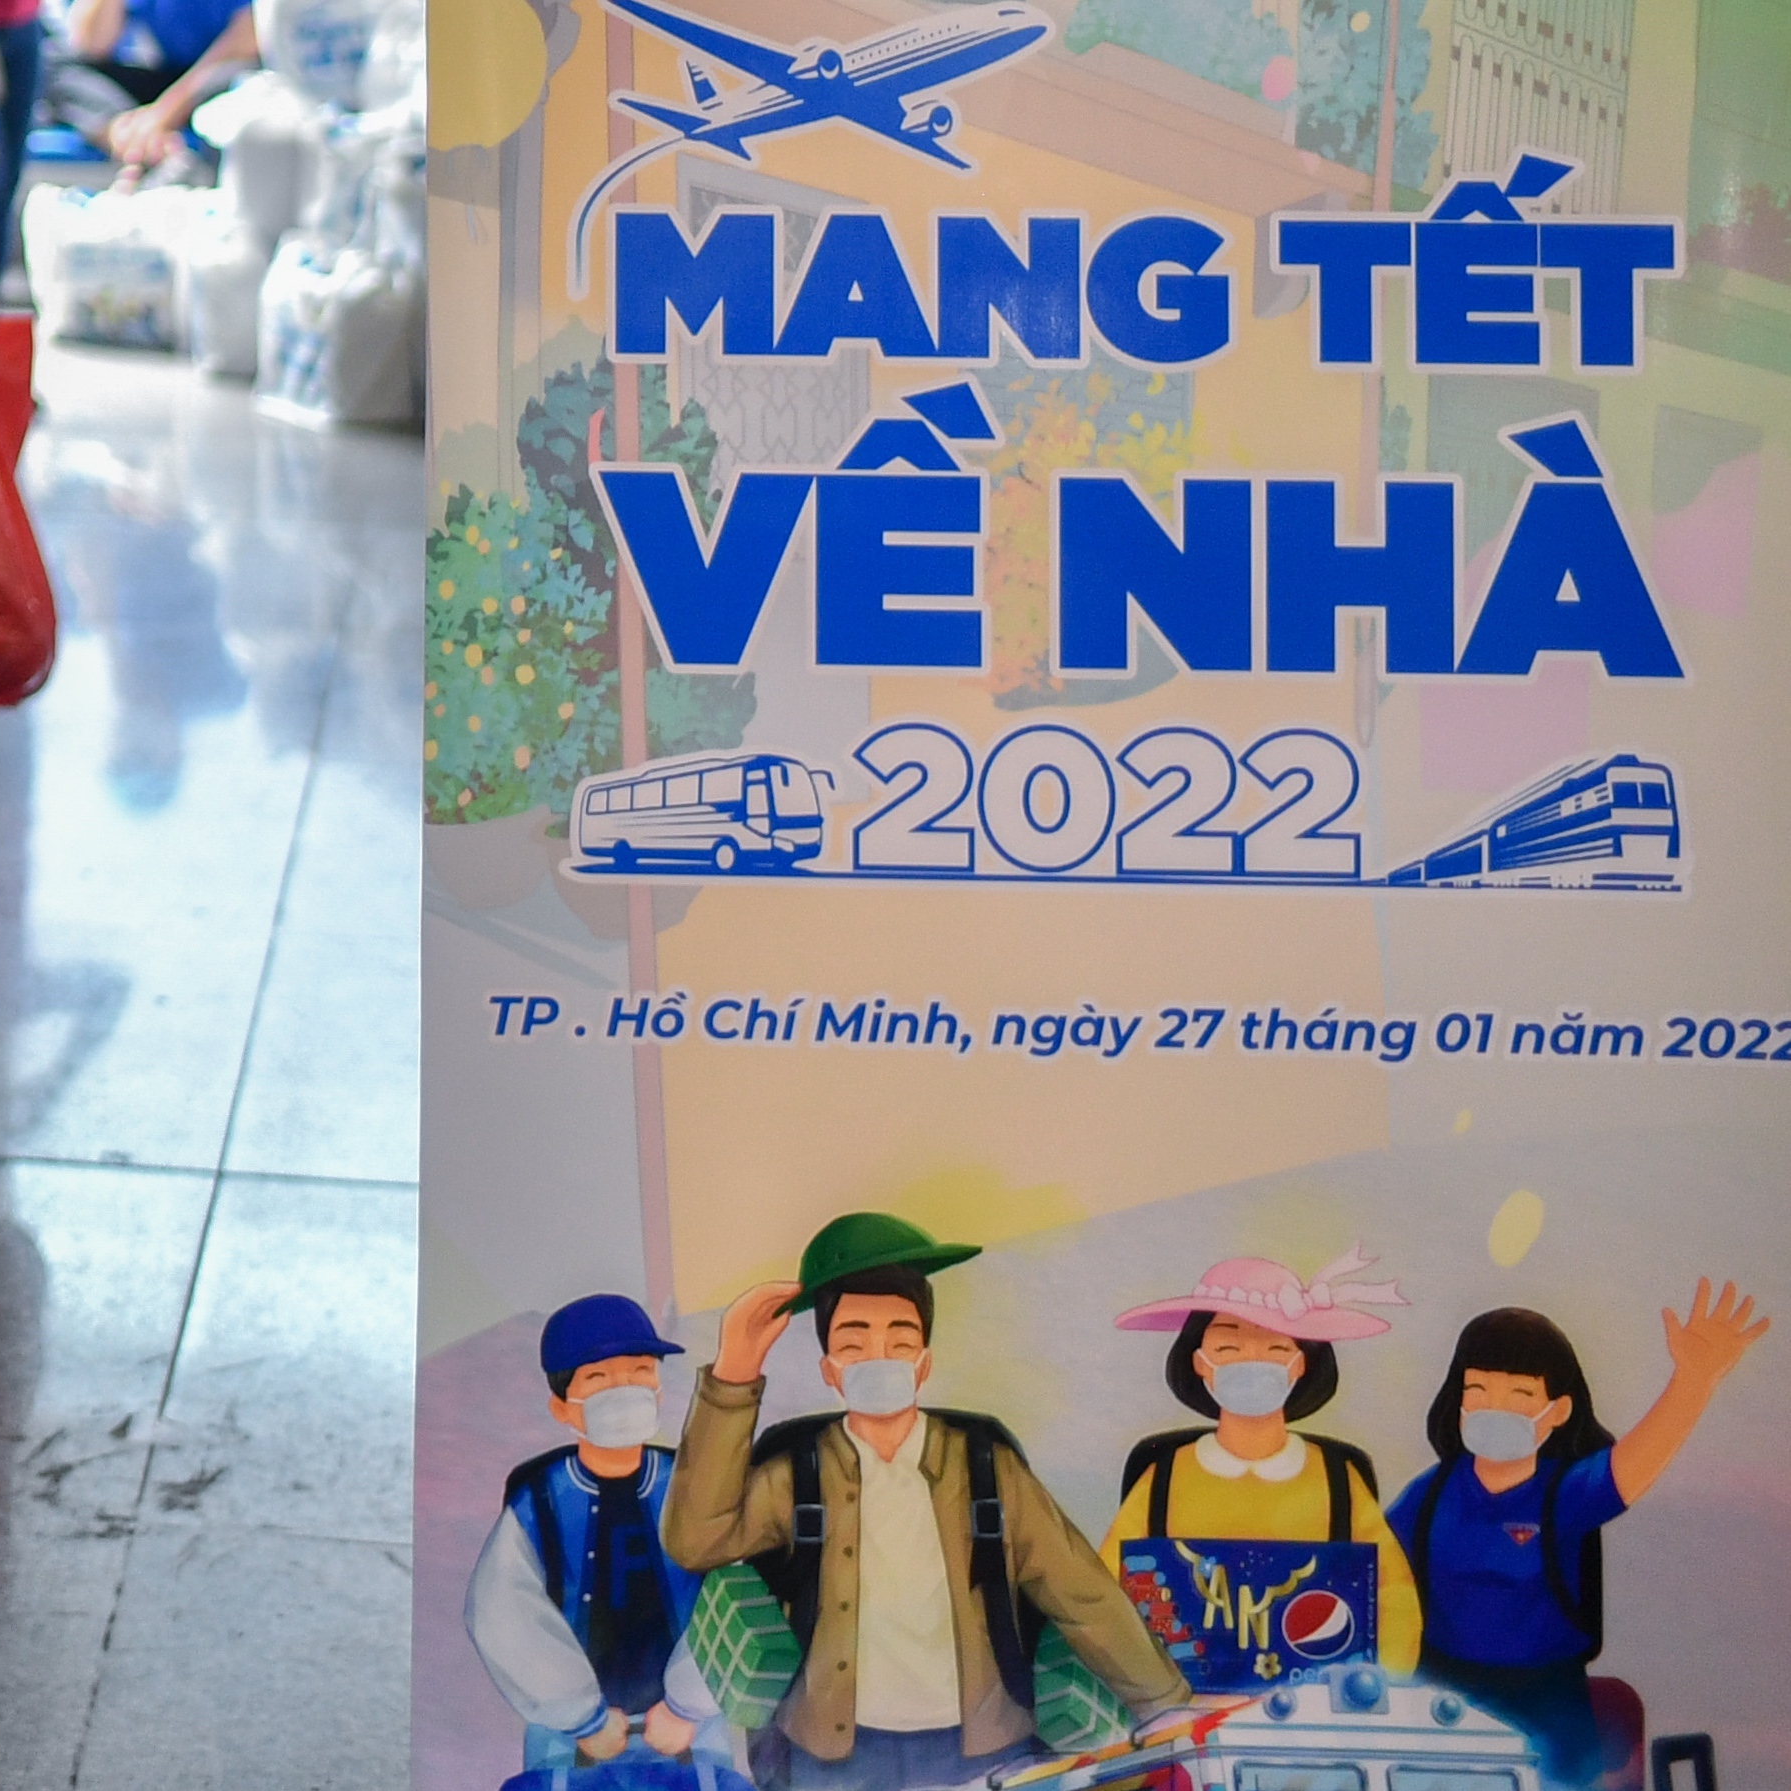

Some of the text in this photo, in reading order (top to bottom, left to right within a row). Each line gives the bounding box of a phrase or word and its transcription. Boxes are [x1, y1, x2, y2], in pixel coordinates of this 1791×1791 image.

[615, 153, 1674, 366] MANG TẾT
[600, 382, 1685, 679] VỀ NHÀ
[851, 723, 1362, 876] 2022
[607, 991, 686, 1039] Hồ
[703, 999, 798, 1041] Chí
[815, 1000, 973, 1054] Minh,
[992, 1004, 1143, 1057] ngày
[1154, 1008, 1225, 1049] 27
[1241, 1008, 1417, 1063] tháng
[1436, 1012, 1493, 1054] 01
[1511, 1011, 1645, 1056] năm
